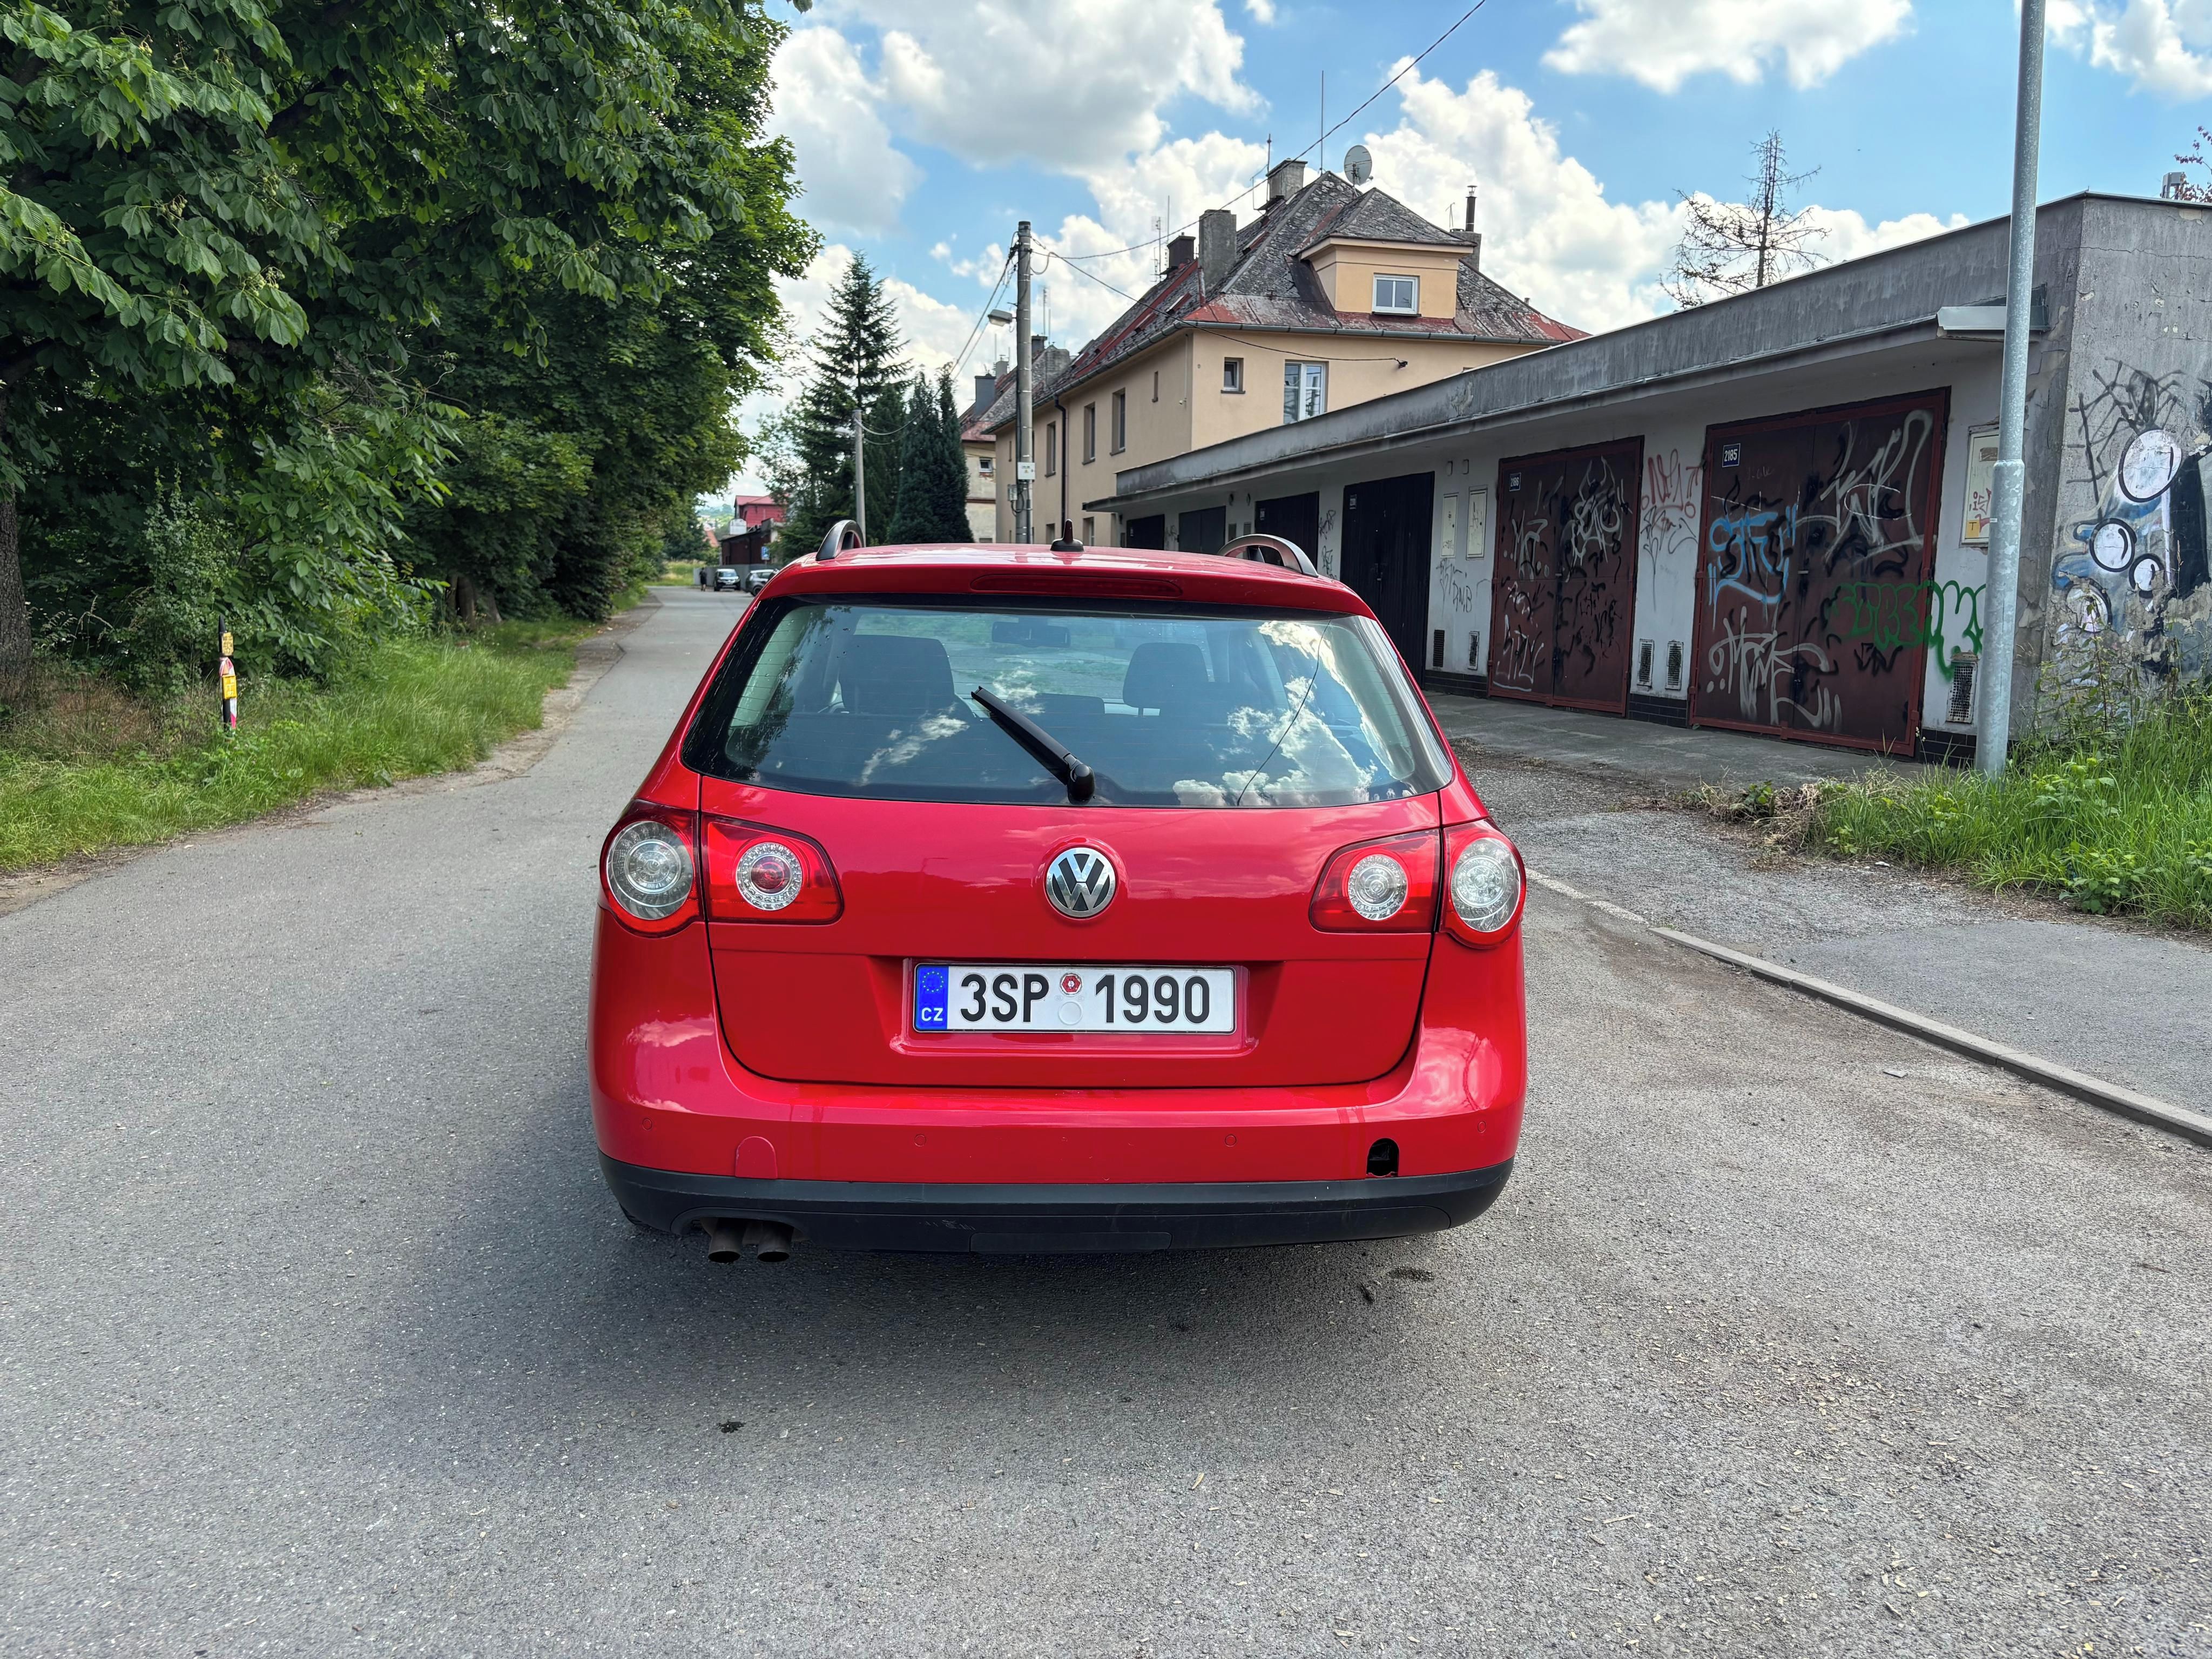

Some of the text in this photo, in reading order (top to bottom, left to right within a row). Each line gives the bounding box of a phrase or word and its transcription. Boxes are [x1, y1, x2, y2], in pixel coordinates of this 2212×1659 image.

[1724, 449, 1738, 462] 2185
[1969, 522, 1977, 530] T
[961, 974, 1209, 1023] 3SP 1990
[922, 1008, 943, 1021] CZ
